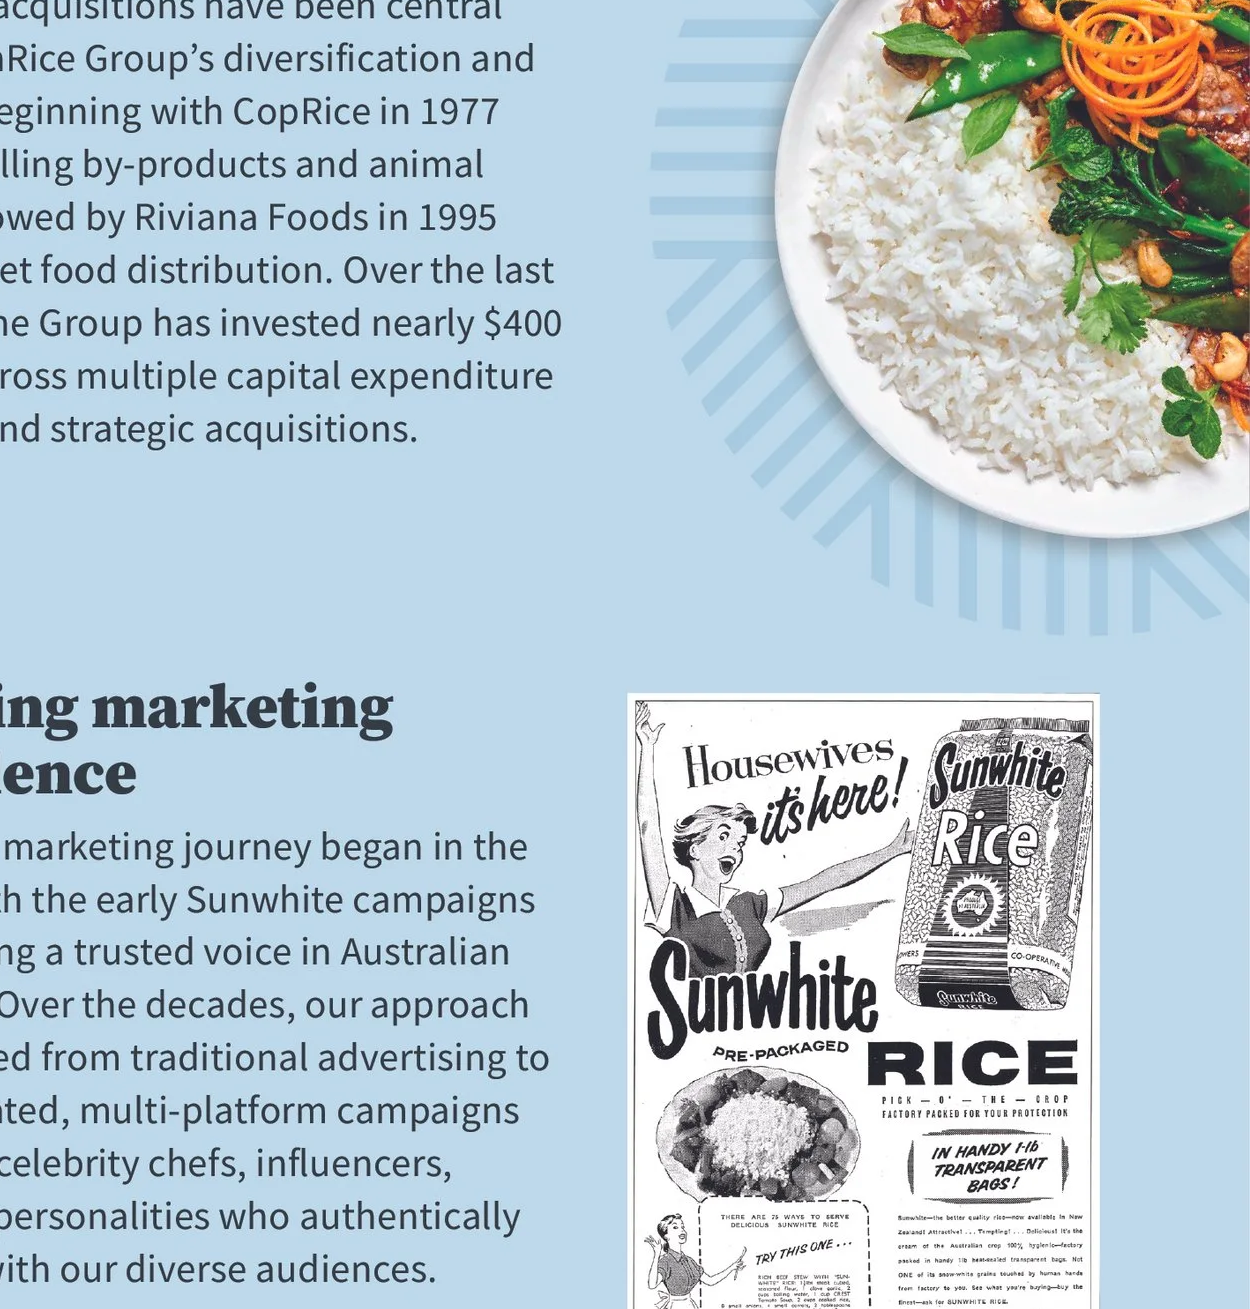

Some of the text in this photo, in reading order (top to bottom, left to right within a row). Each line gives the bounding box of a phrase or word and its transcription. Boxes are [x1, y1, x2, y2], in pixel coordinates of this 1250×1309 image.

[92, 682, 393, 741] marketing
[682, 739, 895, 789] Housewives
[928, 741, 1067, 810] Sunwhite
[807, 756, 909, 831] here!
[931, 809, 1039, 867] Rice
[647, 939, 879, 1060] Sunwhite
[713, 1041, 849, 1062] PRE-PACKAGED
[868, 1040, 1078, 1086] RICE
[82, 1094, 325, 1132] multi-platform
[338, 1096, 519, 1132] campaigns
[926, 1110, 960, 1118] PACKED
[964, 1110, 980, 1118] FOR
[985, 1110, 1008, 1118] YOUR
[1013, 1109, 1068, 1117] PROTECTION
[934, 1157, 1048, 1177] TRANSPARENT
